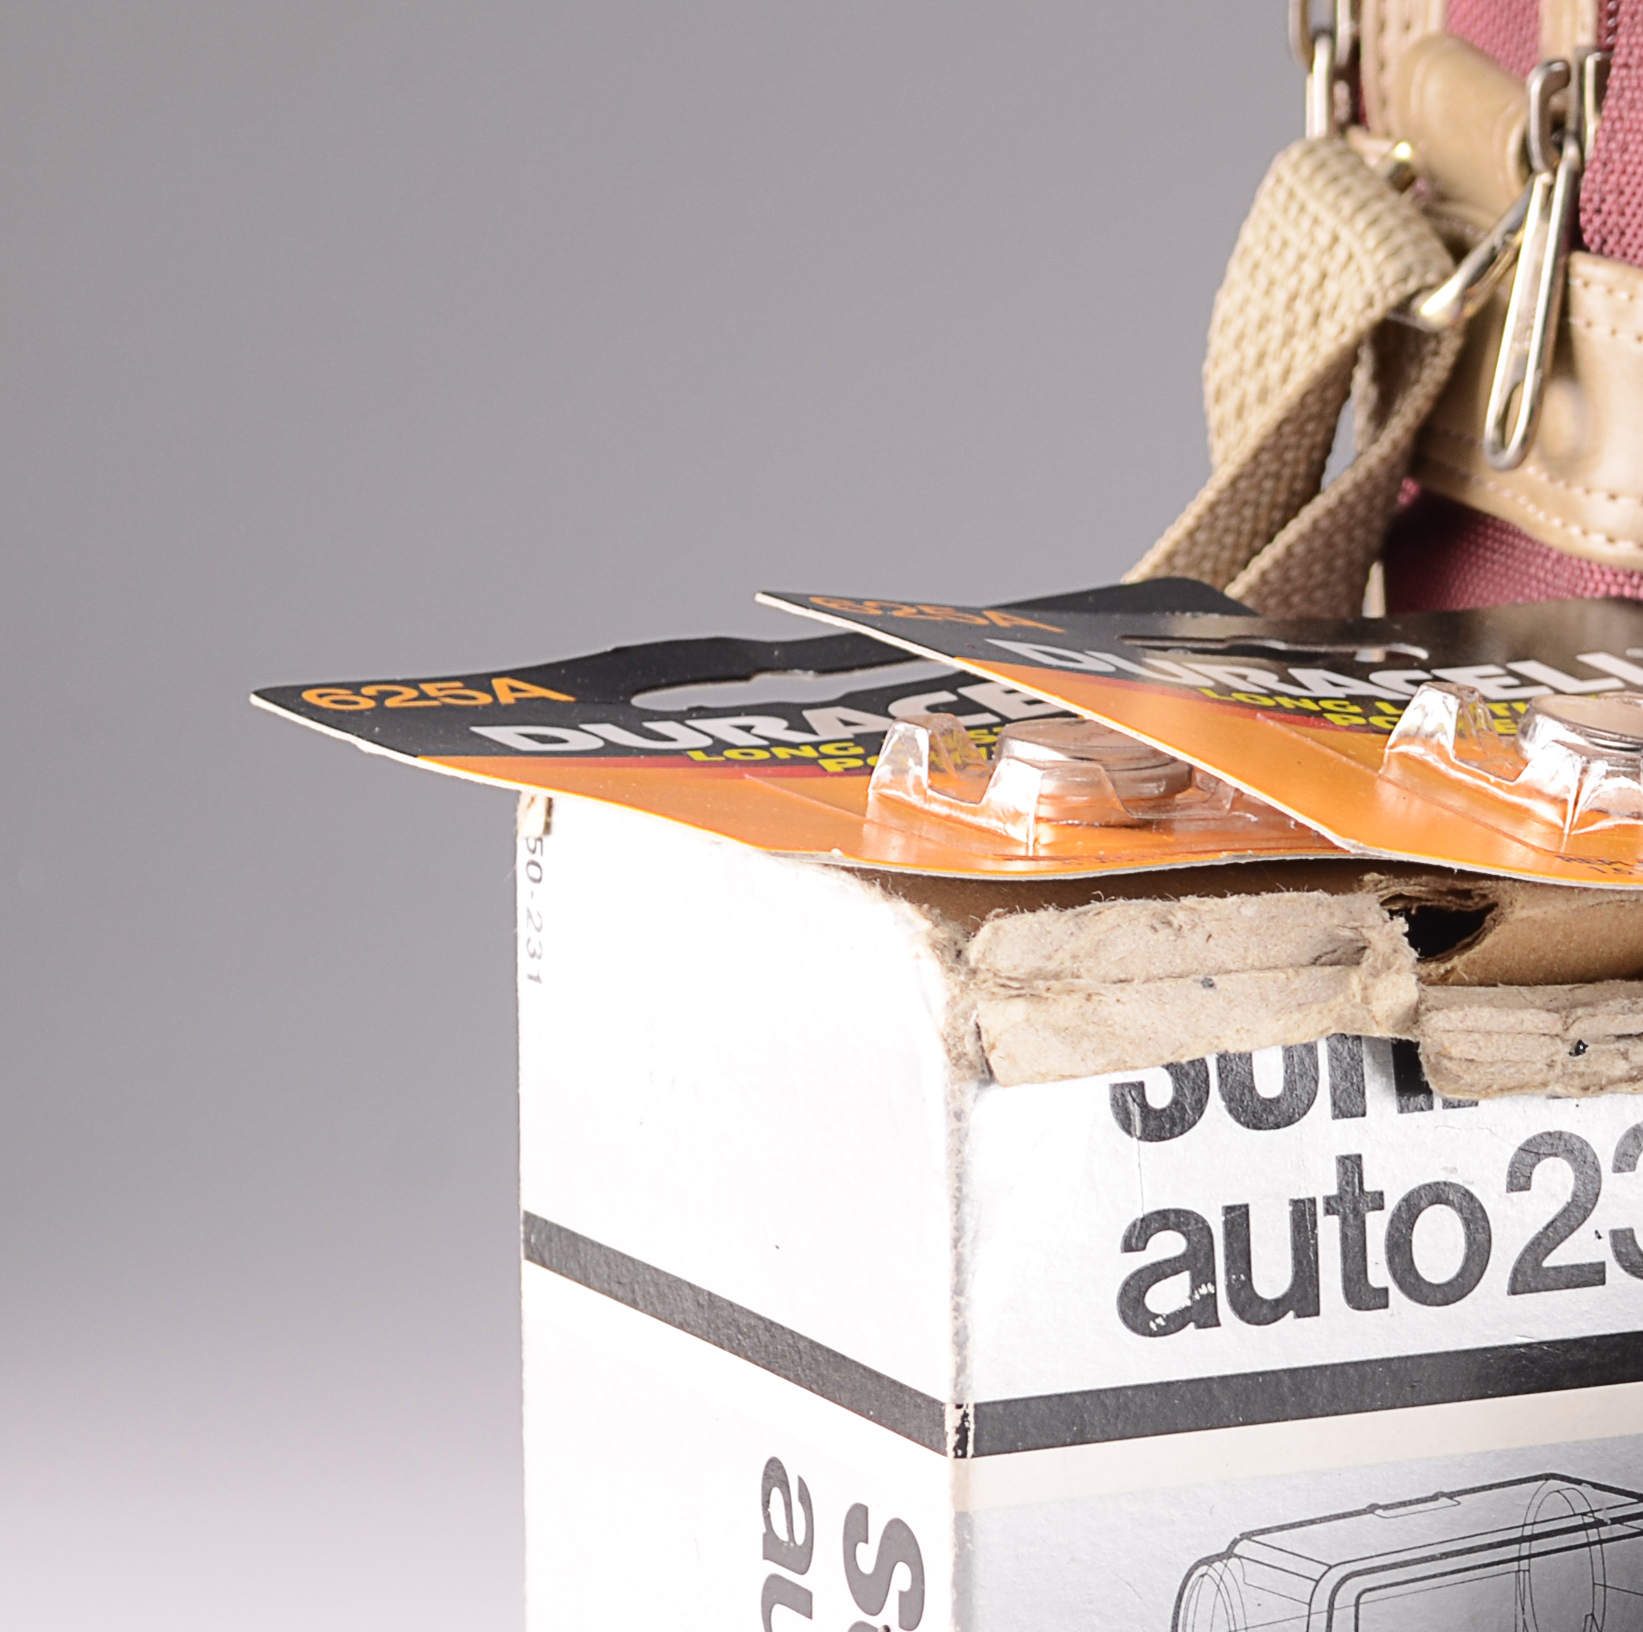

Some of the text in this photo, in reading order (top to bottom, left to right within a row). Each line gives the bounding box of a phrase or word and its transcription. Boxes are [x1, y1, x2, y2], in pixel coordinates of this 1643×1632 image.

[301, 677, 576, 712] 625A
[1198, 687, 1363, 713] LONG
[470, 682, 1080, 752] DURACE
[686, 742, 864, 763] LONG
